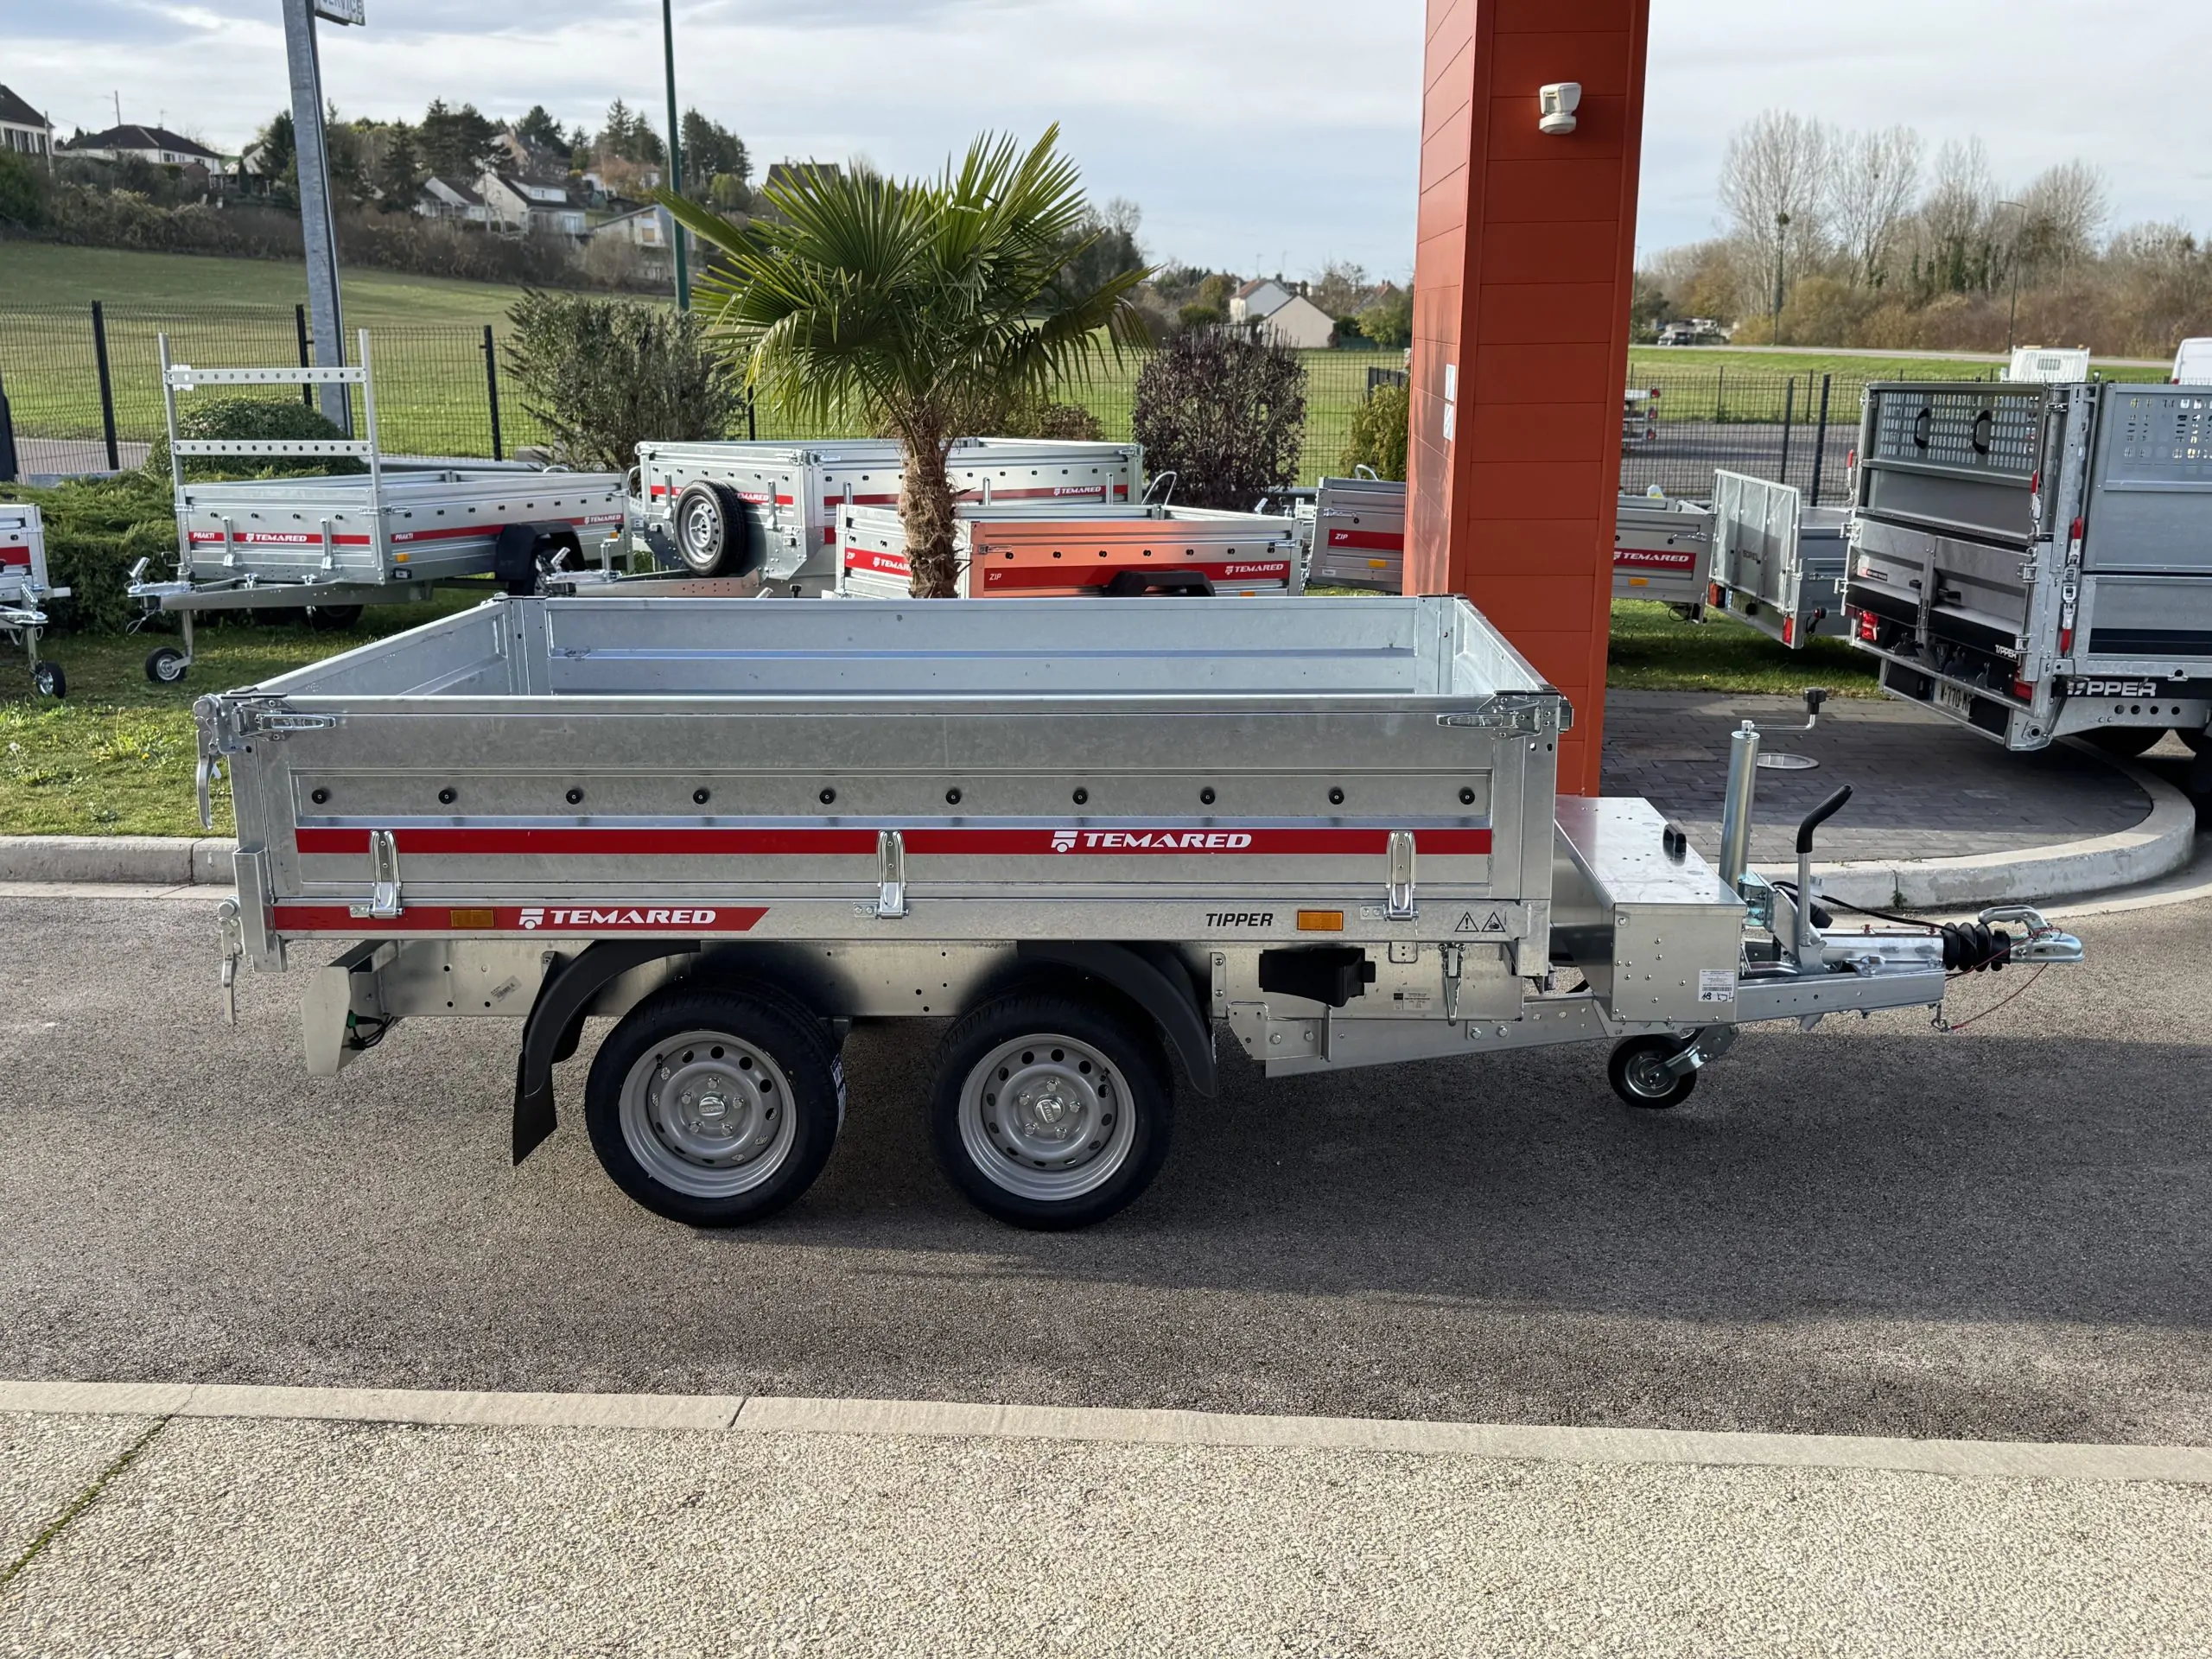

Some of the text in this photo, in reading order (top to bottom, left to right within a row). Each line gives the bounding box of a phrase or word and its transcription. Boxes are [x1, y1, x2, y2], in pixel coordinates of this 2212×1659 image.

[323, 0, 364, 16] RVICE
[736, 493, 769, 501] EMARED
[590, 514, 621, 523] TEMARED
[255, 533, 308, 543] TEMARED
[395, 532, 414, 541] PRAKTI
[1623, 551, 1690, 563] TEMARED
[1234, 563, 1284, 574] TEMARED
[988, 572, 1002, 581] ZIP
[1083, 832, 1253, 849] TEMARED
[550, 909, 717, 925] TEMARED
[1205, 912, 1274, 927] TIPPER
